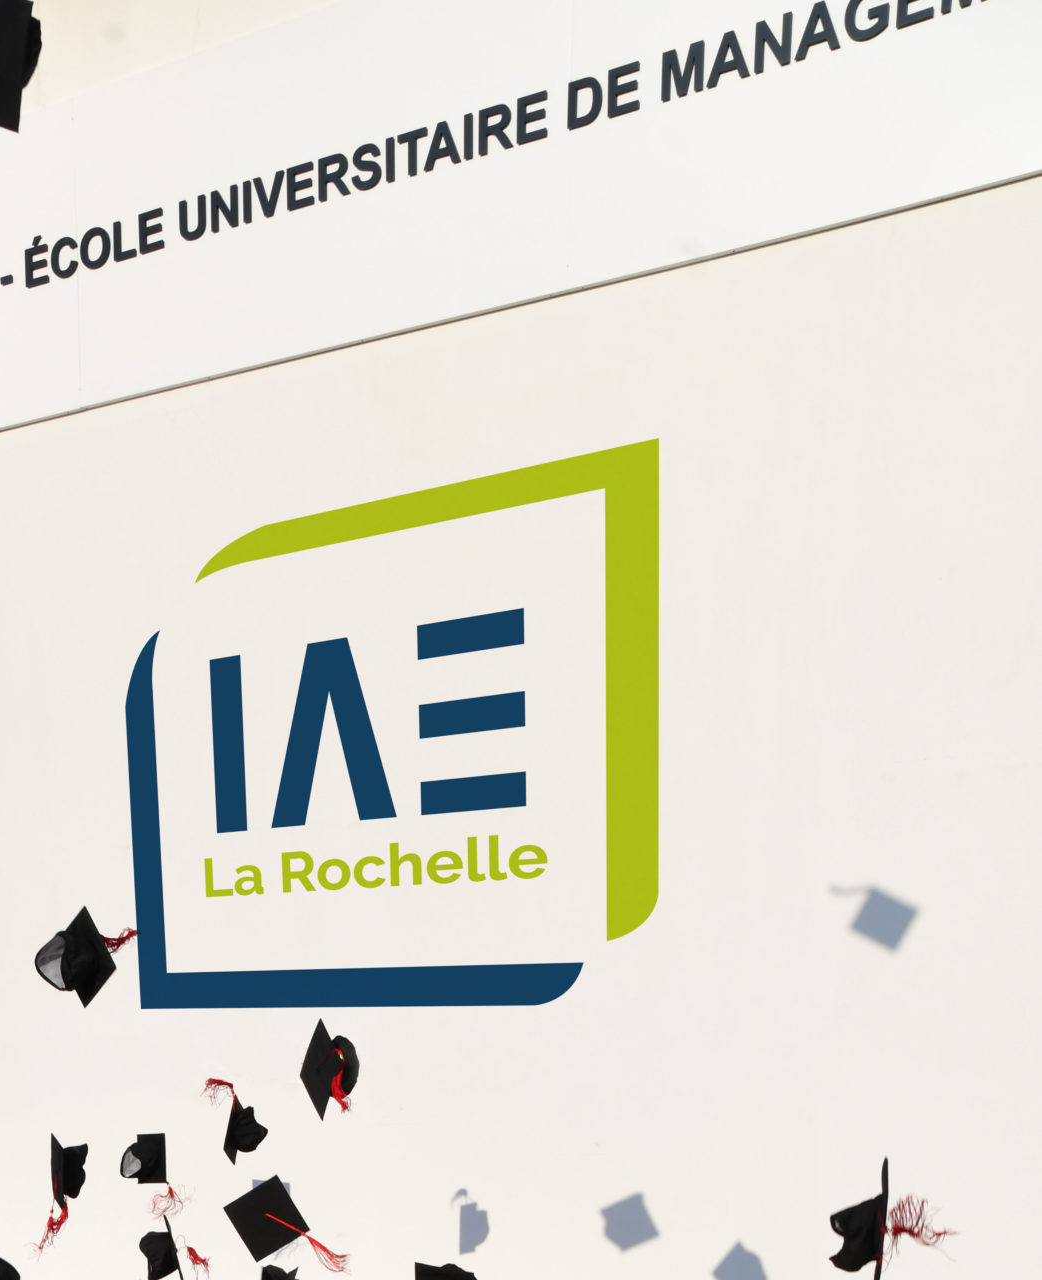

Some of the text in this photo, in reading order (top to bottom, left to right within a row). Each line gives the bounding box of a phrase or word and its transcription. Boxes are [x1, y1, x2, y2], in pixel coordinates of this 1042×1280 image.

[1, 275, 14, 286] -
[25, 208, 165, 289] ÉCOLE
[179, 91, 548, 242] UNIVERSITAIRE
[568, 61, 641, 131] DE
[209, 607, 527, 834] IAE
[204, 834, 548, 898] La Rochelle
